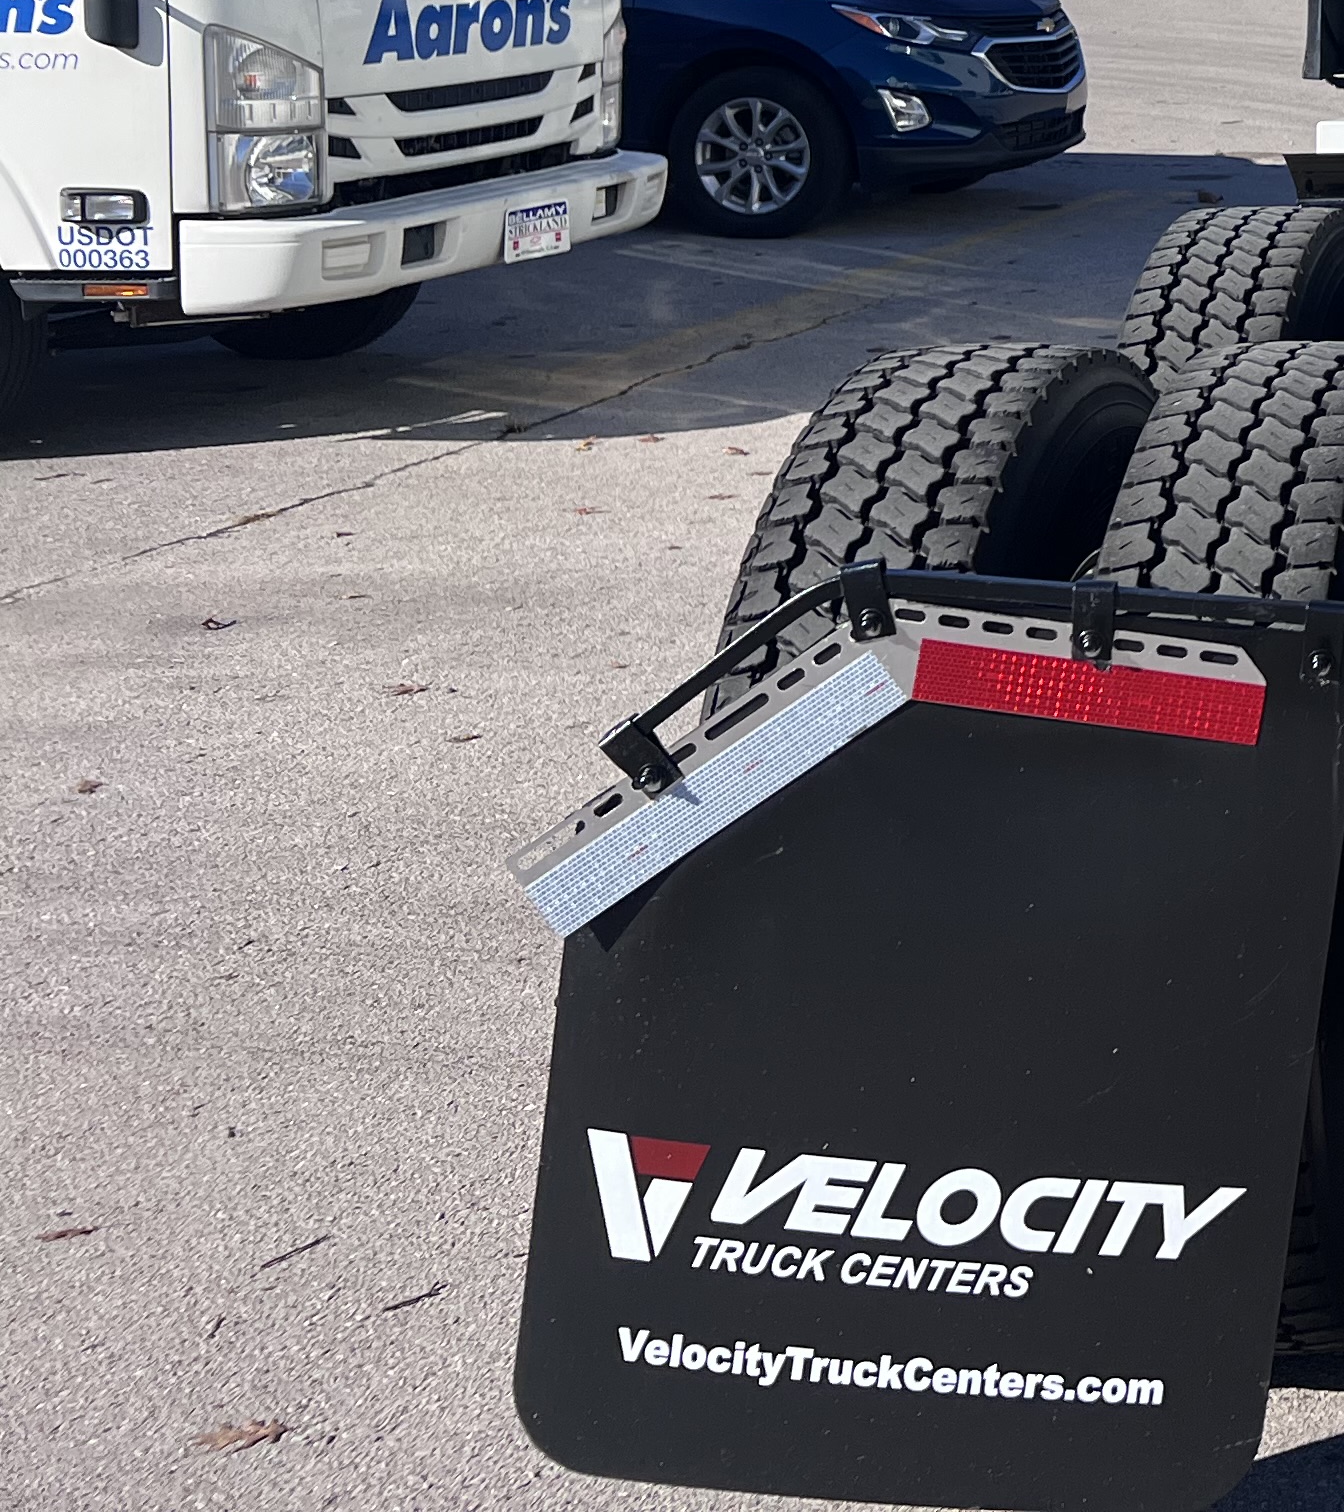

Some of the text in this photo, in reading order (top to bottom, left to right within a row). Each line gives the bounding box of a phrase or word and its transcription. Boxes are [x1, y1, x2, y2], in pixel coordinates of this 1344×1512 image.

[57, 225, 154, 246] USDOT
[508, 203, 567, 226] BELLAMY
[59, 248, 150, 269] 000363
[710, 1147, 1248, 1260] VELOCITY
[691, 1236, 1034, 1298] TRUCK CENTERS
[618, 1326, 1164, 1405] VelocityTruckCenters.com
